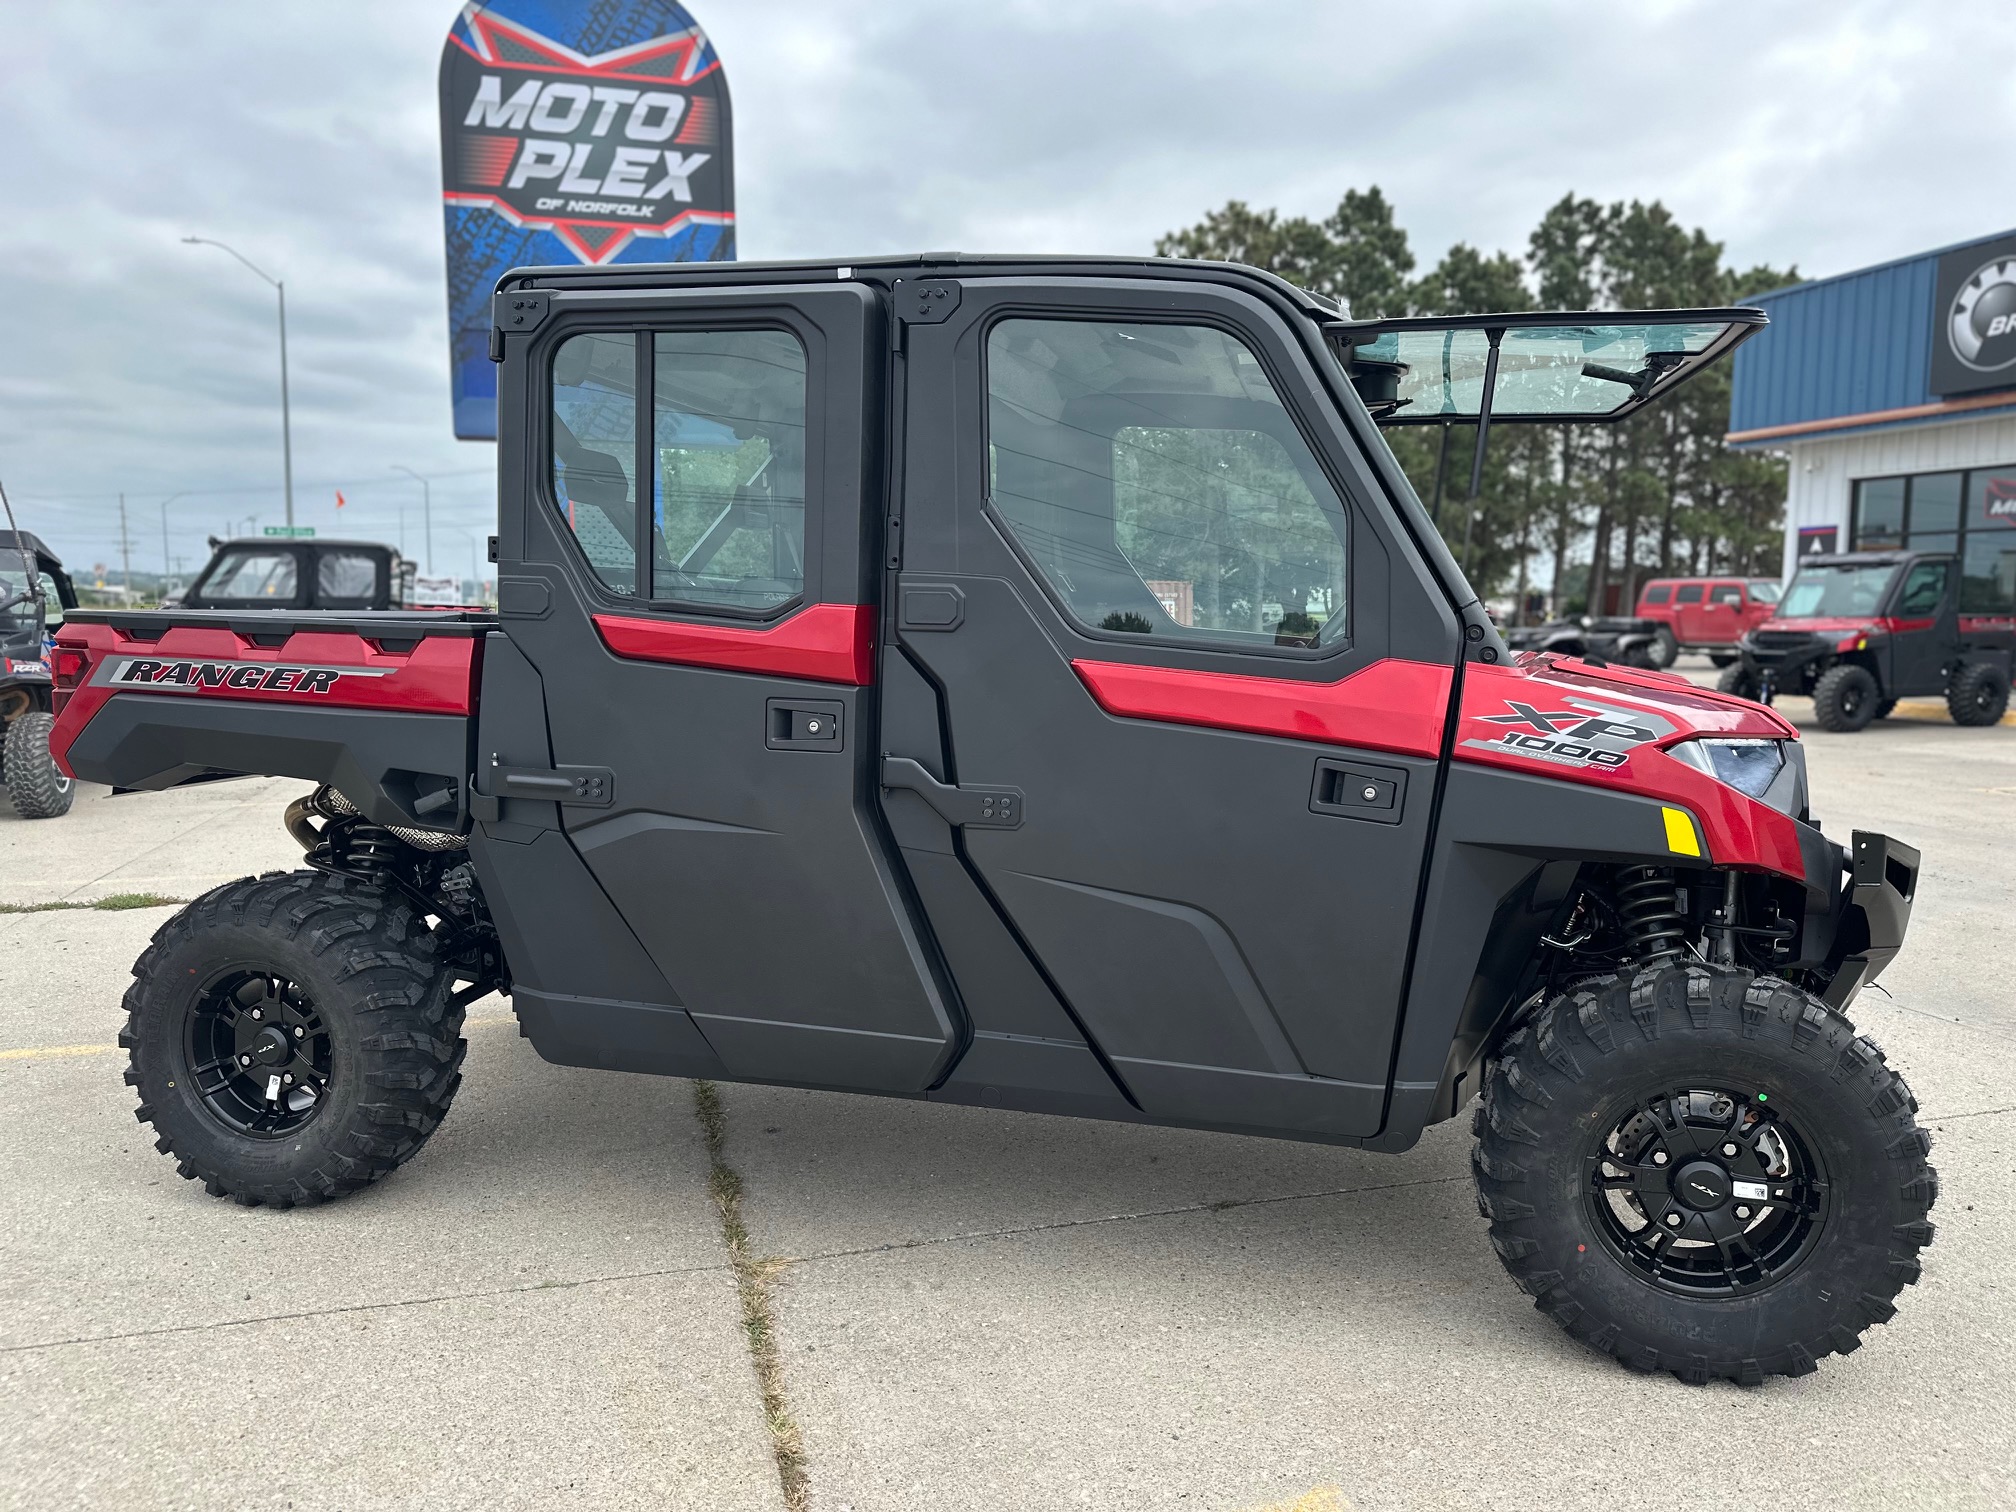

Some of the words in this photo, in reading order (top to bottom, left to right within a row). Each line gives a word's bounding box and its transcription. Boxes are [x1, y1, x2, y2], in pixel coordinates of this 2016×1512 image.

[464, 75, 686, 142] MOTO
[507, 138, 711, 202] PLEX
[536, 198, 565, 210] OF
[567, 199, 656, 217] NORFOLK
[13, 664, 41, 673] RZR
[120, 660, 340, 694] RANGER
[1471, 699, 1660, 744] XP
[1497, 745, 1526, 756] DUAL
[1589, 763, 1616, 773] CAM
[1499, 731, 1630, 768] 1000
